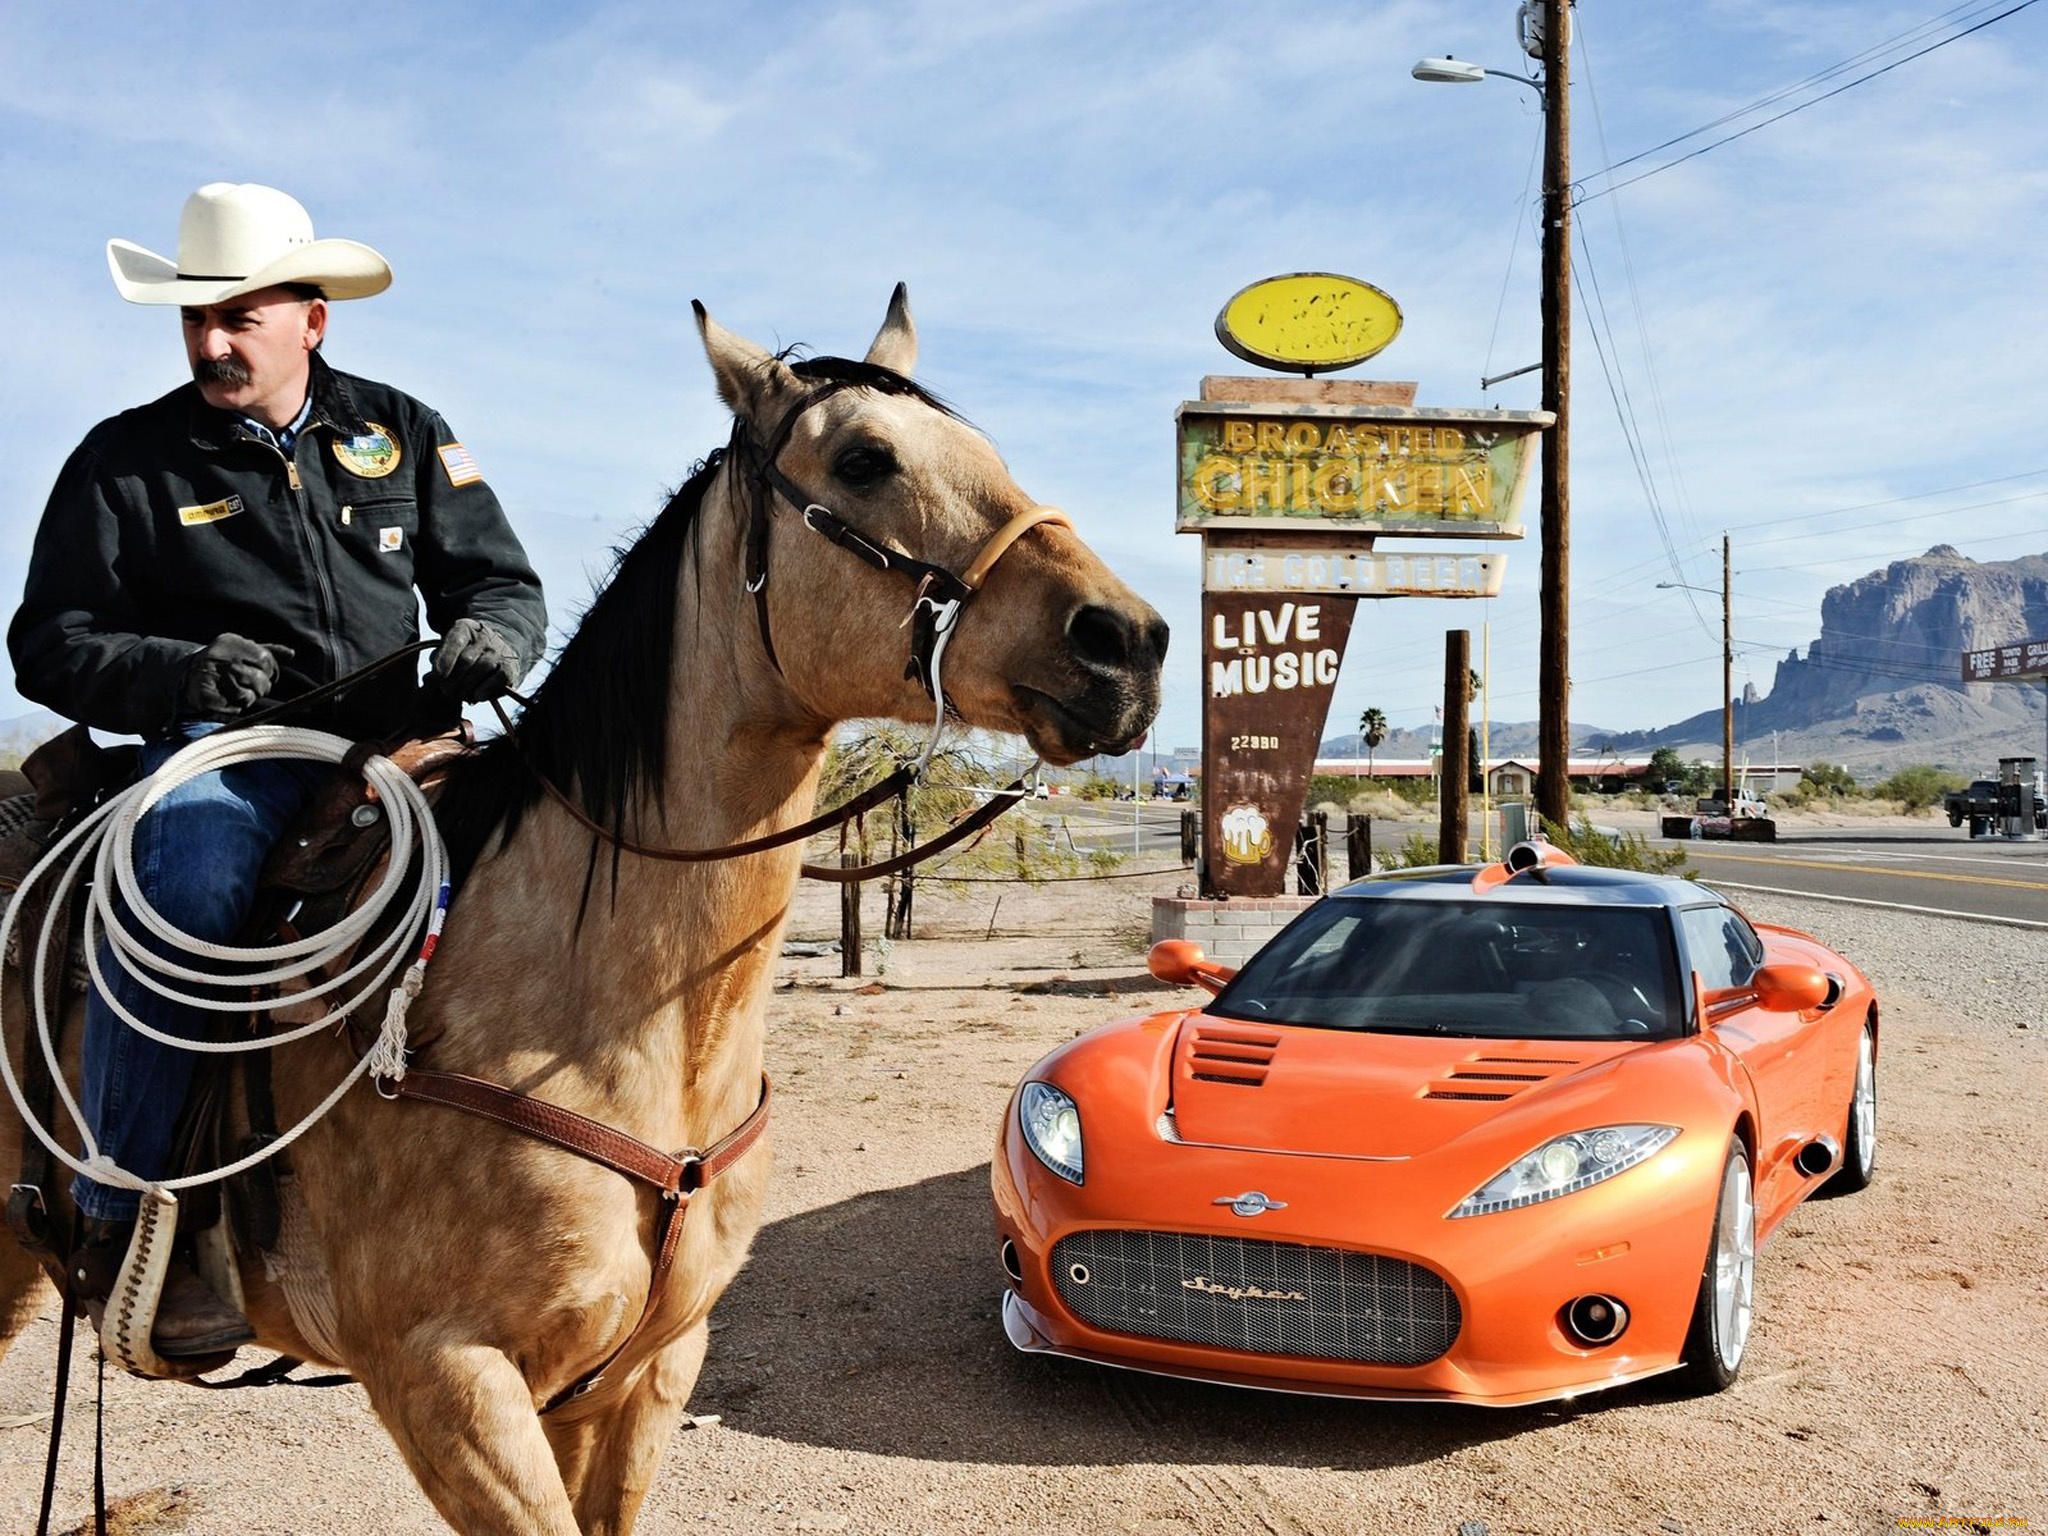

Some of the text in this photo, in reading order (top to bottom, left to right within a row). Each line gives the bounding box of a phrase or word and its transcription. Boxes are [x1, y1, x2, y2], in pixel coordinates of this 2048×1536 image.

[1224, 421, 1465, 455] BROASTED
[1194, 455, 1493, 514] CHICKEN
[1213, 552, 1481, 588] ICE COLD BEER
[1212, 602, 1321, 650] LIVE
[1211, 649, 1339, 698] MUSIC
[1970, 651, 1996, 671] FREE
[1182, 1276, 1306, 1300] Spyker
